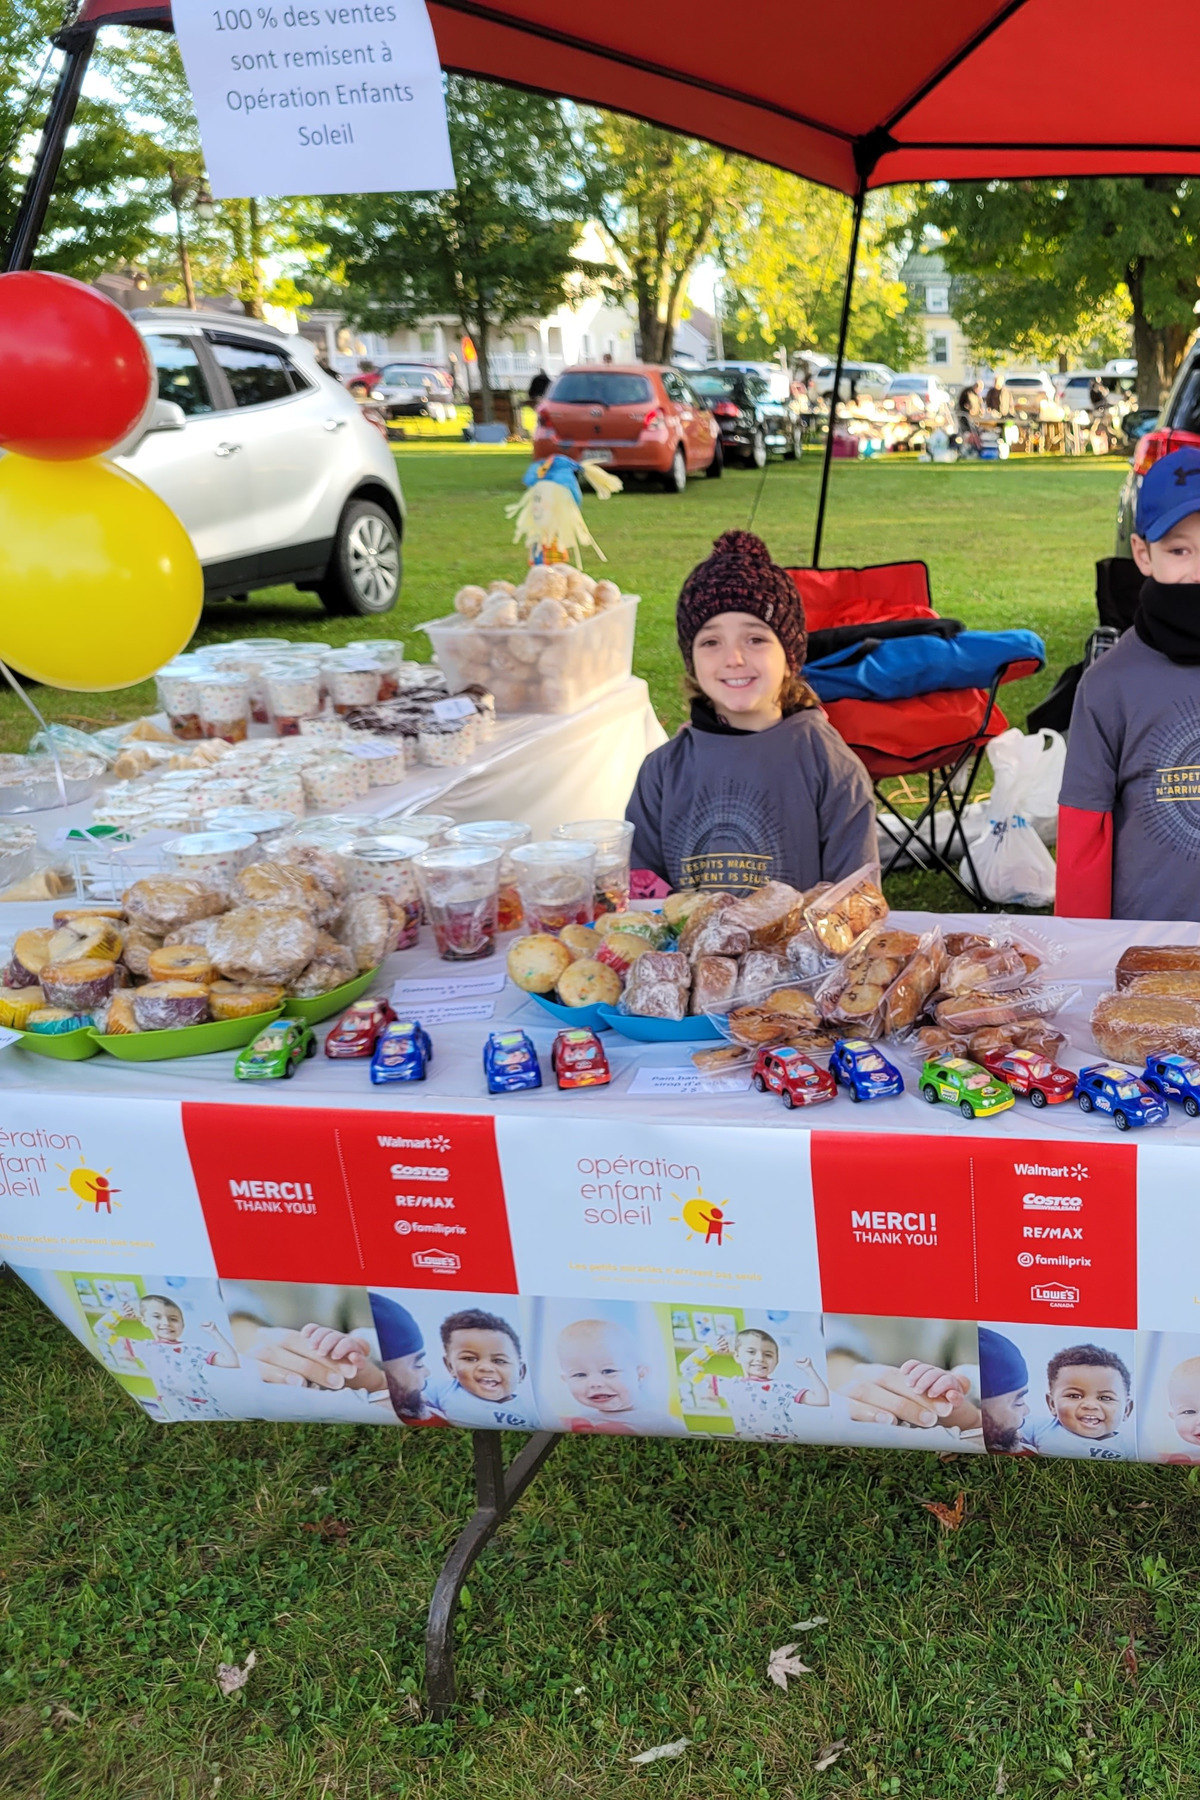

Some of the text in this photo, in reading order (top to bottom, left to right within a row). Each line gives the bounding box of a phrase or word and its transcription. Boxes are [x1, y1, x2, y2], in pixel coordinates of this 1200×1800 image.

[213, 4, 397, 31] 100 % des ventes
[231, 41, 393, 71] sont remisent à
[226, 82, 414, 115] Opération Enfants
[298, 123, 355, 146] Soleil
[1161, 773, 1180, 784] LES
[377, 1135, 433, 1149] Walmart
[577, 1154, 701, 1181] opération
[1013, 1163, 1069, 1177] Walmart
[580, 1180, 662, 1202] enfant
[235, 1200, 317, 1215] THANK YOU!
[395, 1195, 455, 1209] RE/MAX
[1022, 1193, 1083, 1207] COSTCO
[584, 1205, 652, 1225] soleil
[412, 1222, 467, 1236] familiprix
[1023, 1226, 1083, 1240] RE/MAX
[853, 1231, 938, 1246] THANK YOU!
[569, 1261, 587, 1271] Les
[1035, 1253, 1092, 1268] familiprix
